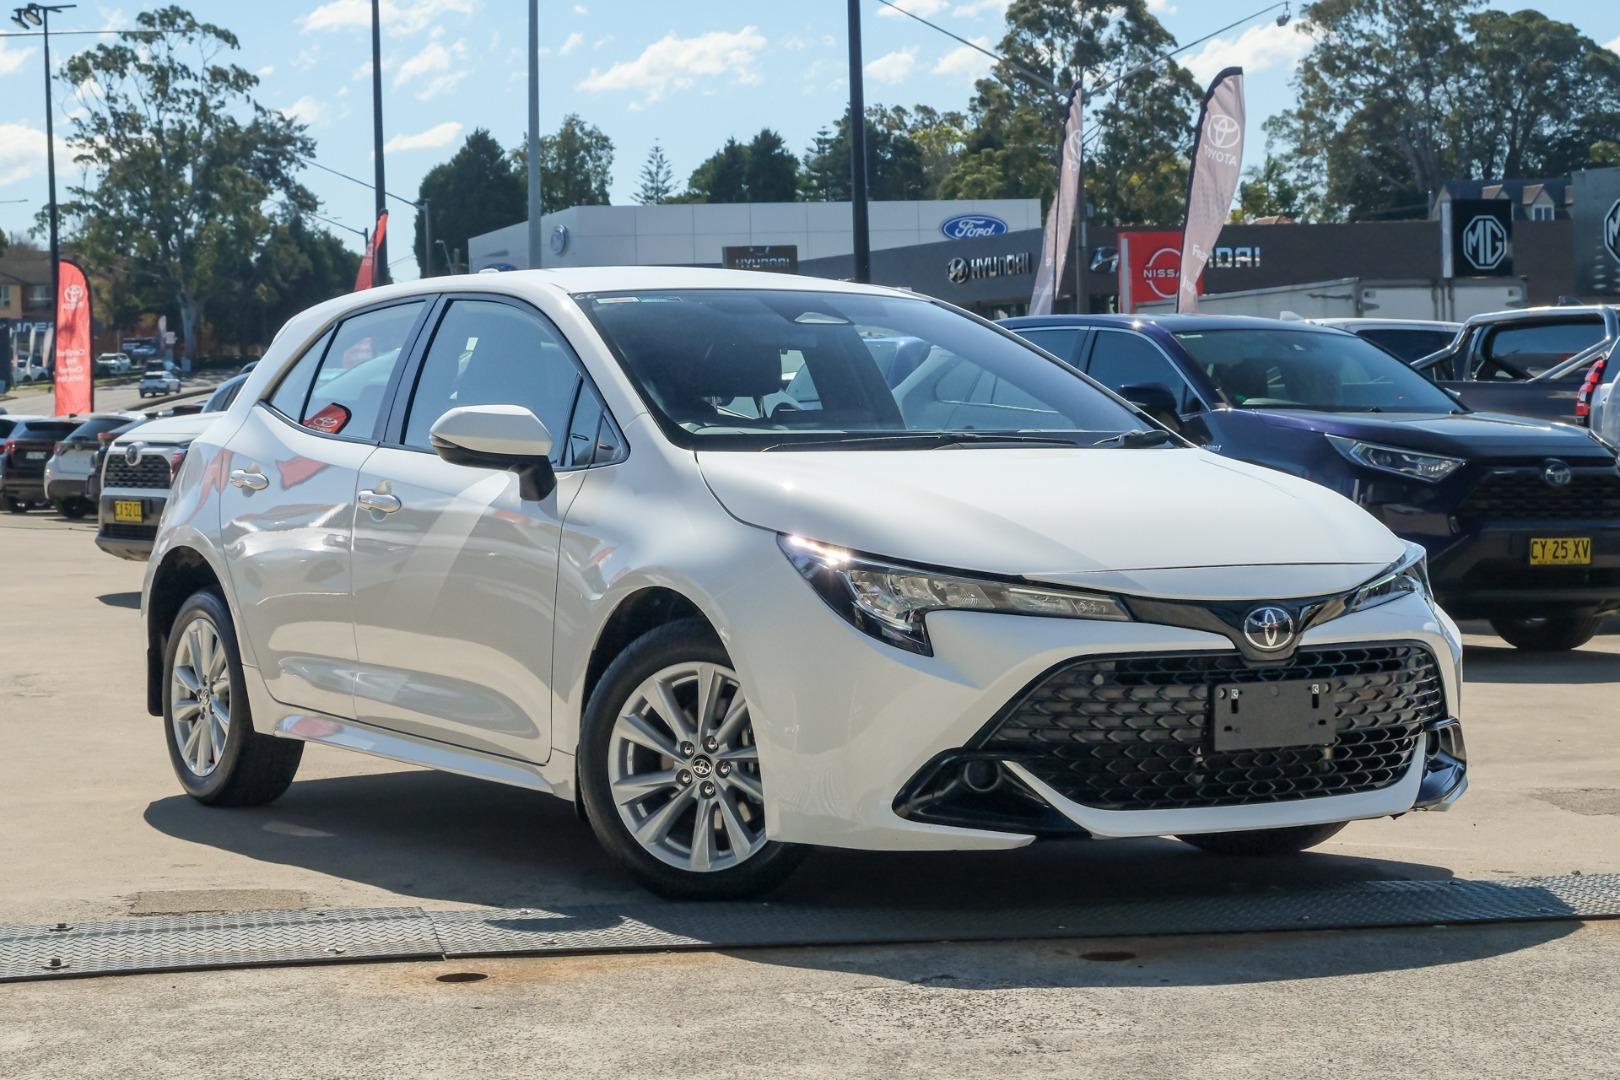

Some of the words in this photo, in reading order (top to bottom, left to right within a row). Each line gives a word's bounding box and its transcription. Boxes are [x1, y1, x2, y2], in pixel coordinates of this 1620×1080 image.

[954, 219, 996, 237] Ford
[1467, 220, 1504, 264] MG
[971, 252, 1031, 279] HYUNDAI
[1143, 269, 1179, 278] NISS
[1531, 541, 1547, 559] CY
[1552, 541, 1568, 559] 25
[1573, 540, 1589, 559] XV
